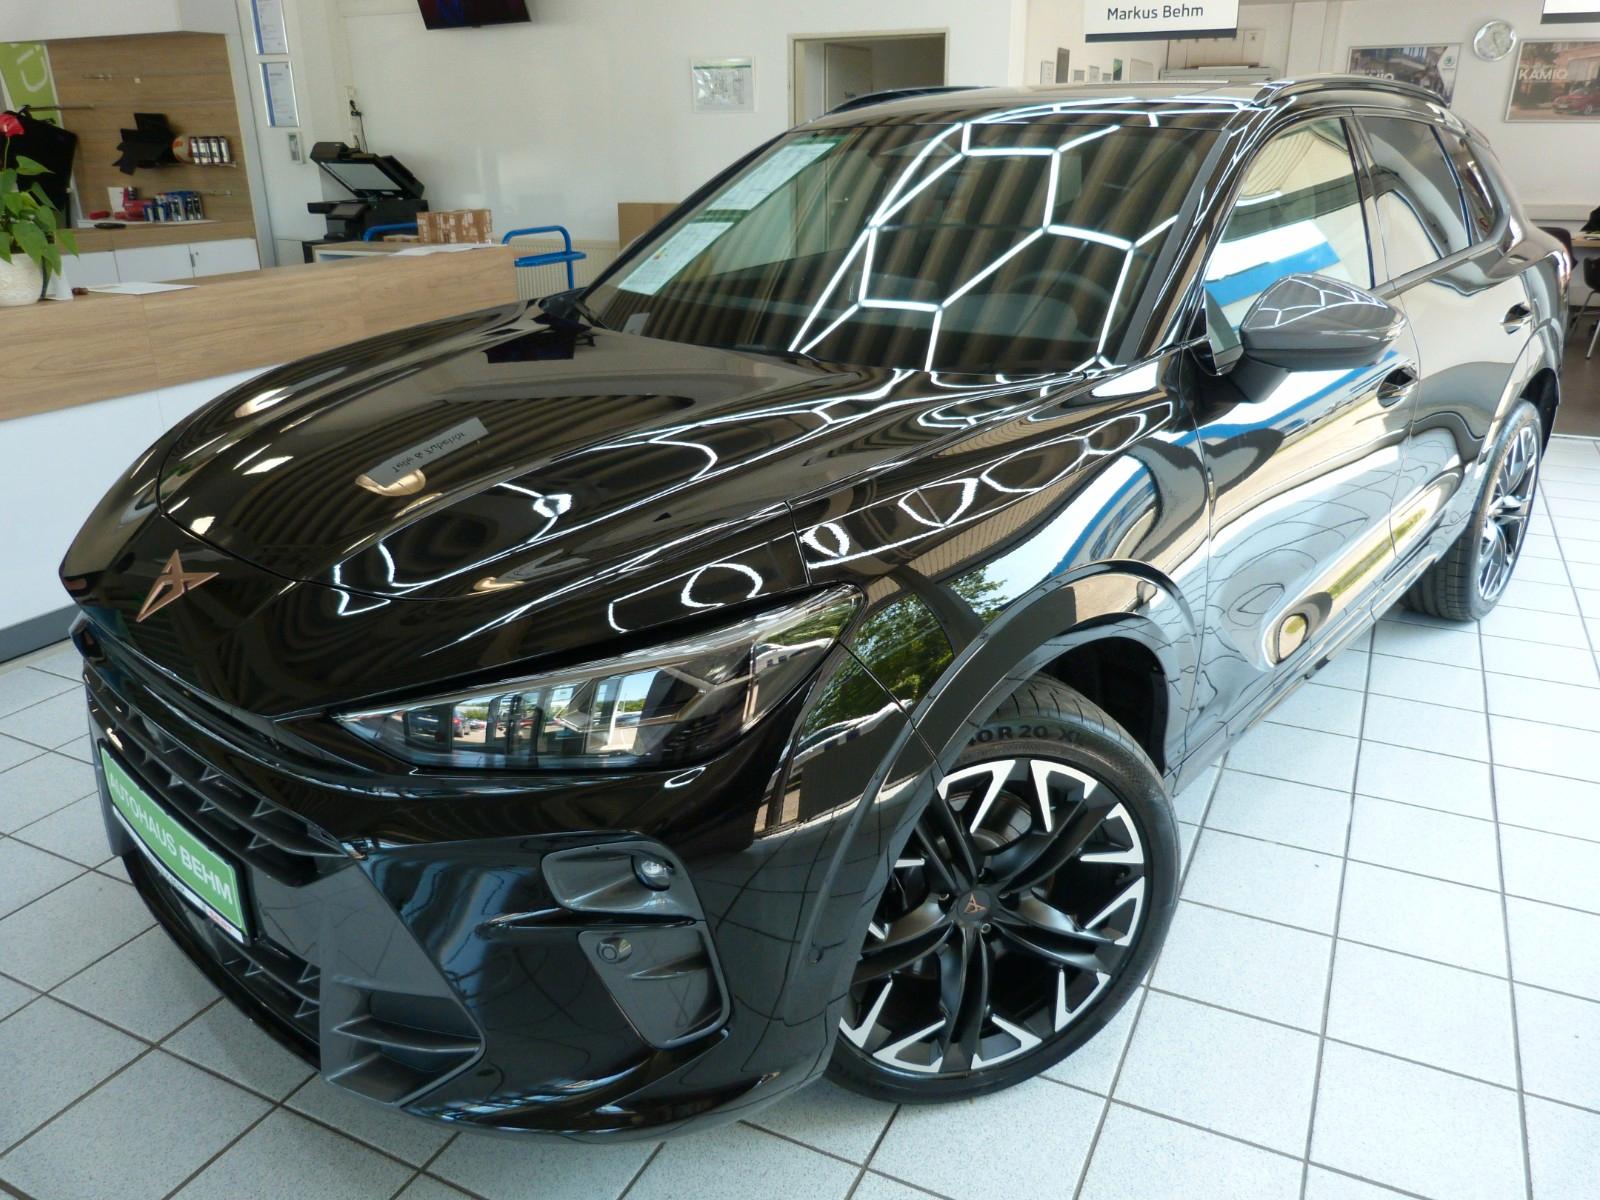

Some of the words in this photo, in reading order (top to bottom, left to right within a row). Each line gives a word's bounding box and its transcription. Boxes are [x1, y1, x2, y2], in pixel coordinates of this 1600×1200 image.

[1107, 6, 1158, 20] Markus
[1163, 4, 1204, 18] Behm
[110, 773, 178, 856] AUTOHAUS
[180, 845, 234, 905] BEHM
